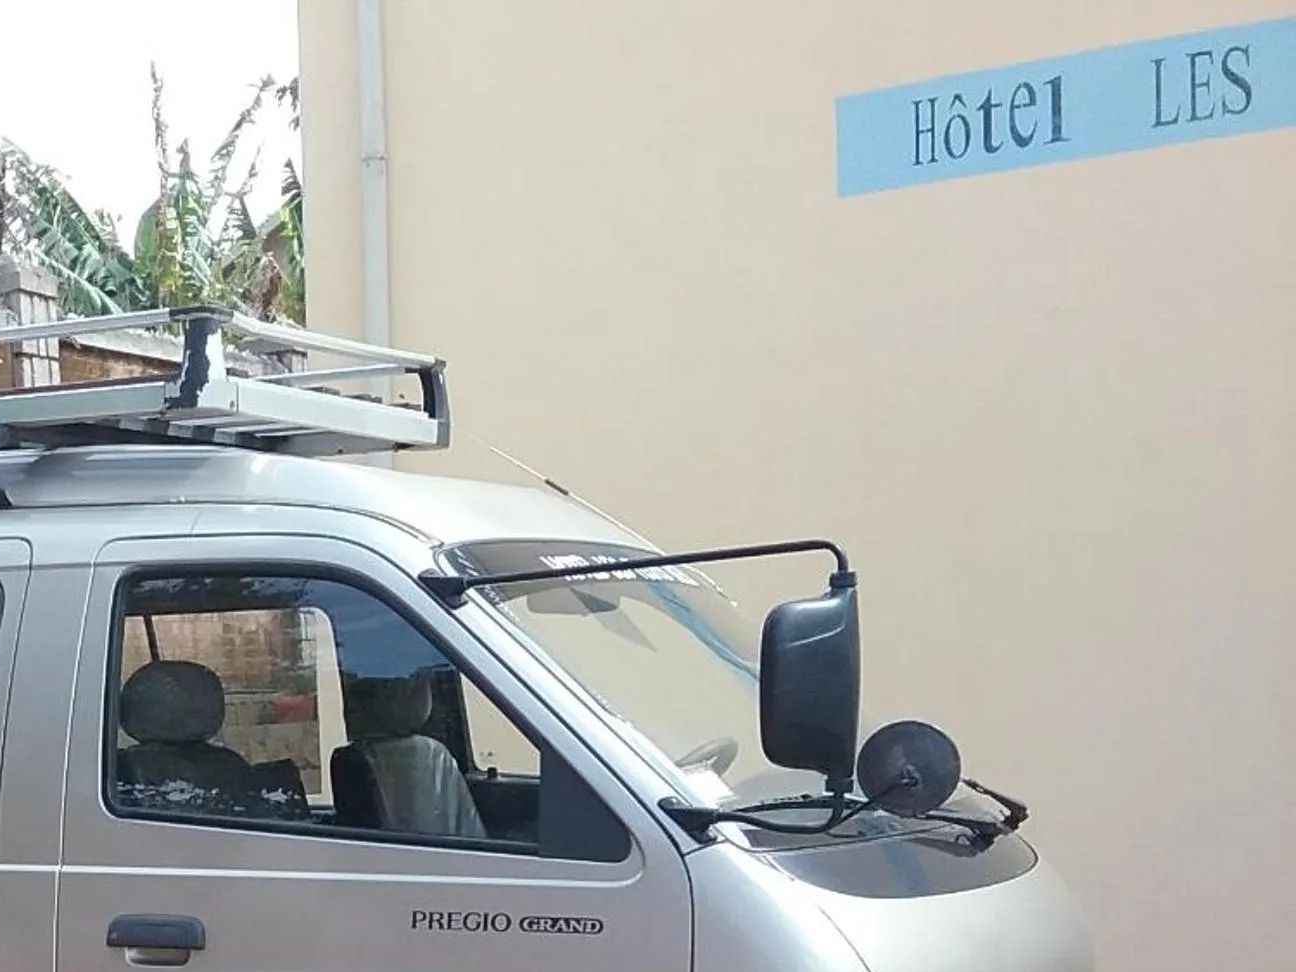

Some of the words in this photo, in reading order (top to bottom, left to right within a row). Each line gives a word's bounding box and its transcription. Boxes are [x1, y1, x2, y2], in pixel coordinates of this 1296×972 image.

[911, 74, 1071, 167] Hôtel
[1150, 44, 1253, 129] LES
[410, 910, 512, 932] PREGIO
[521, 917, 602, 933] GRAND
